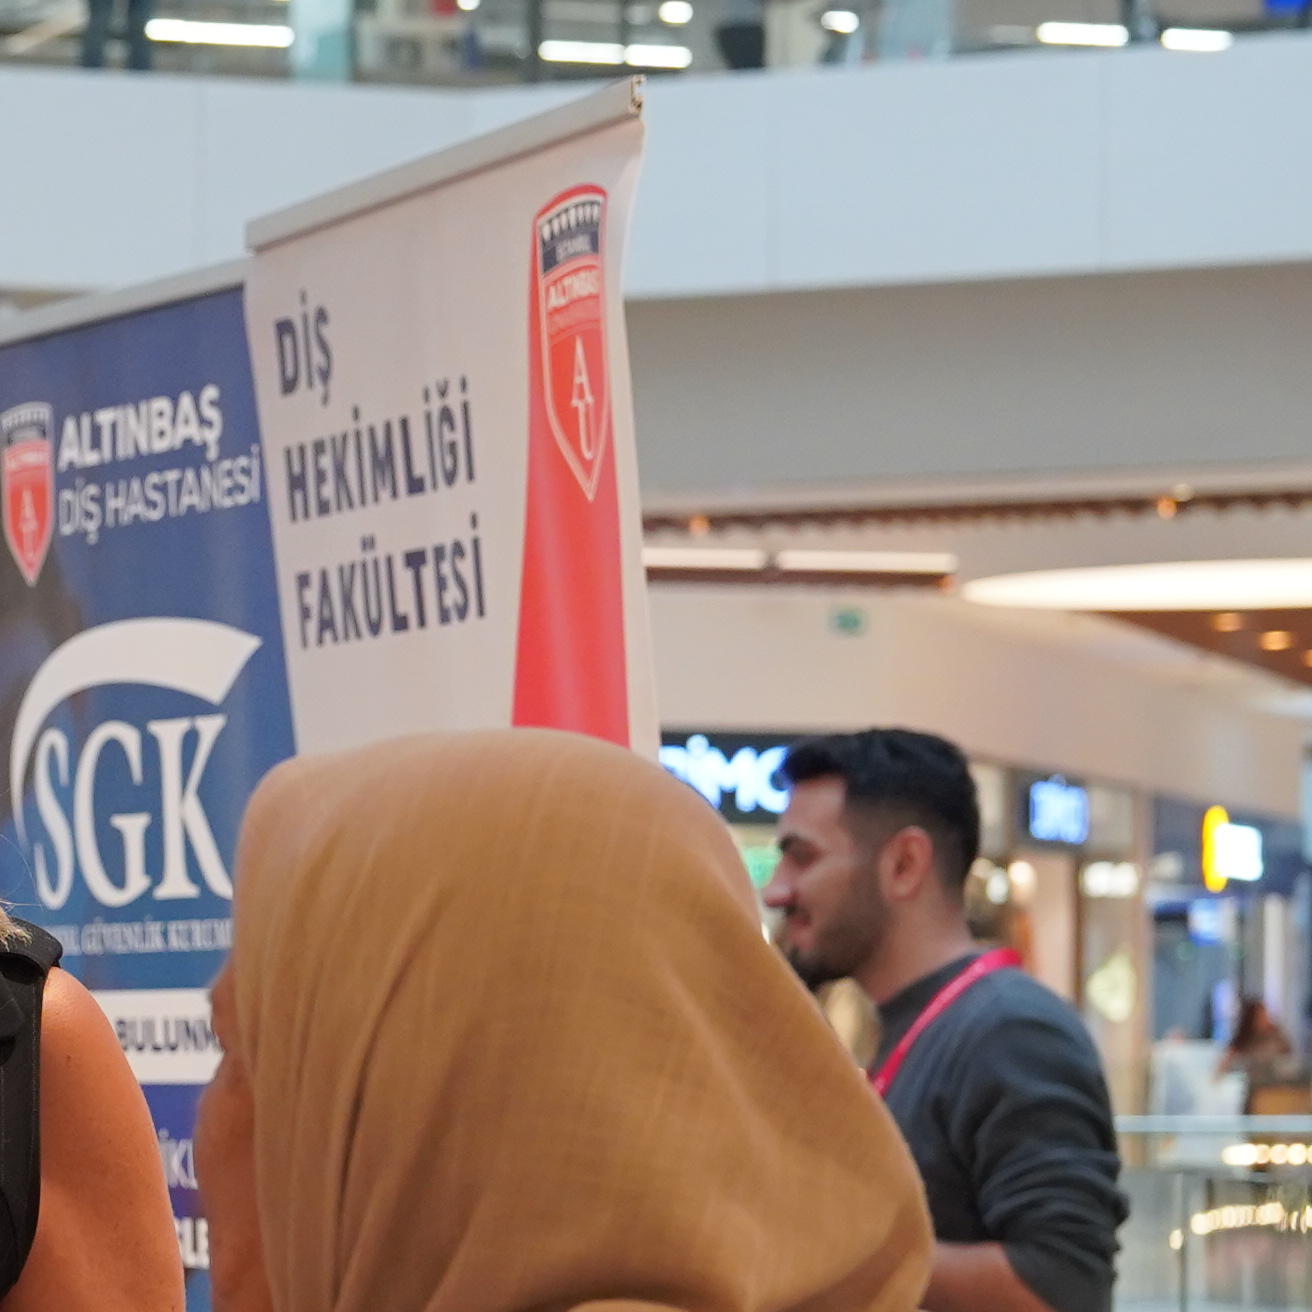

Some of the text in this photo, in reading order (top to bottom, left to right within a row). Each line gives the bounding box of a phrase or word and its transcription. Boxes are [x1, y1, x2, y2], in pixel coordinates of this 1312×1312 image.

[274, 288, 332, 406] DİŞ
[57, 383, 224, 473] ALTINBAŞ
[283, 375, 475, 524] HEKİMLİĞİ
[57, 442, 262, 546] DİŞ HASTANESİ
[295, 511, 486, 650] FAKÜLTESİ
[33, 713, 234, 911] SGK
